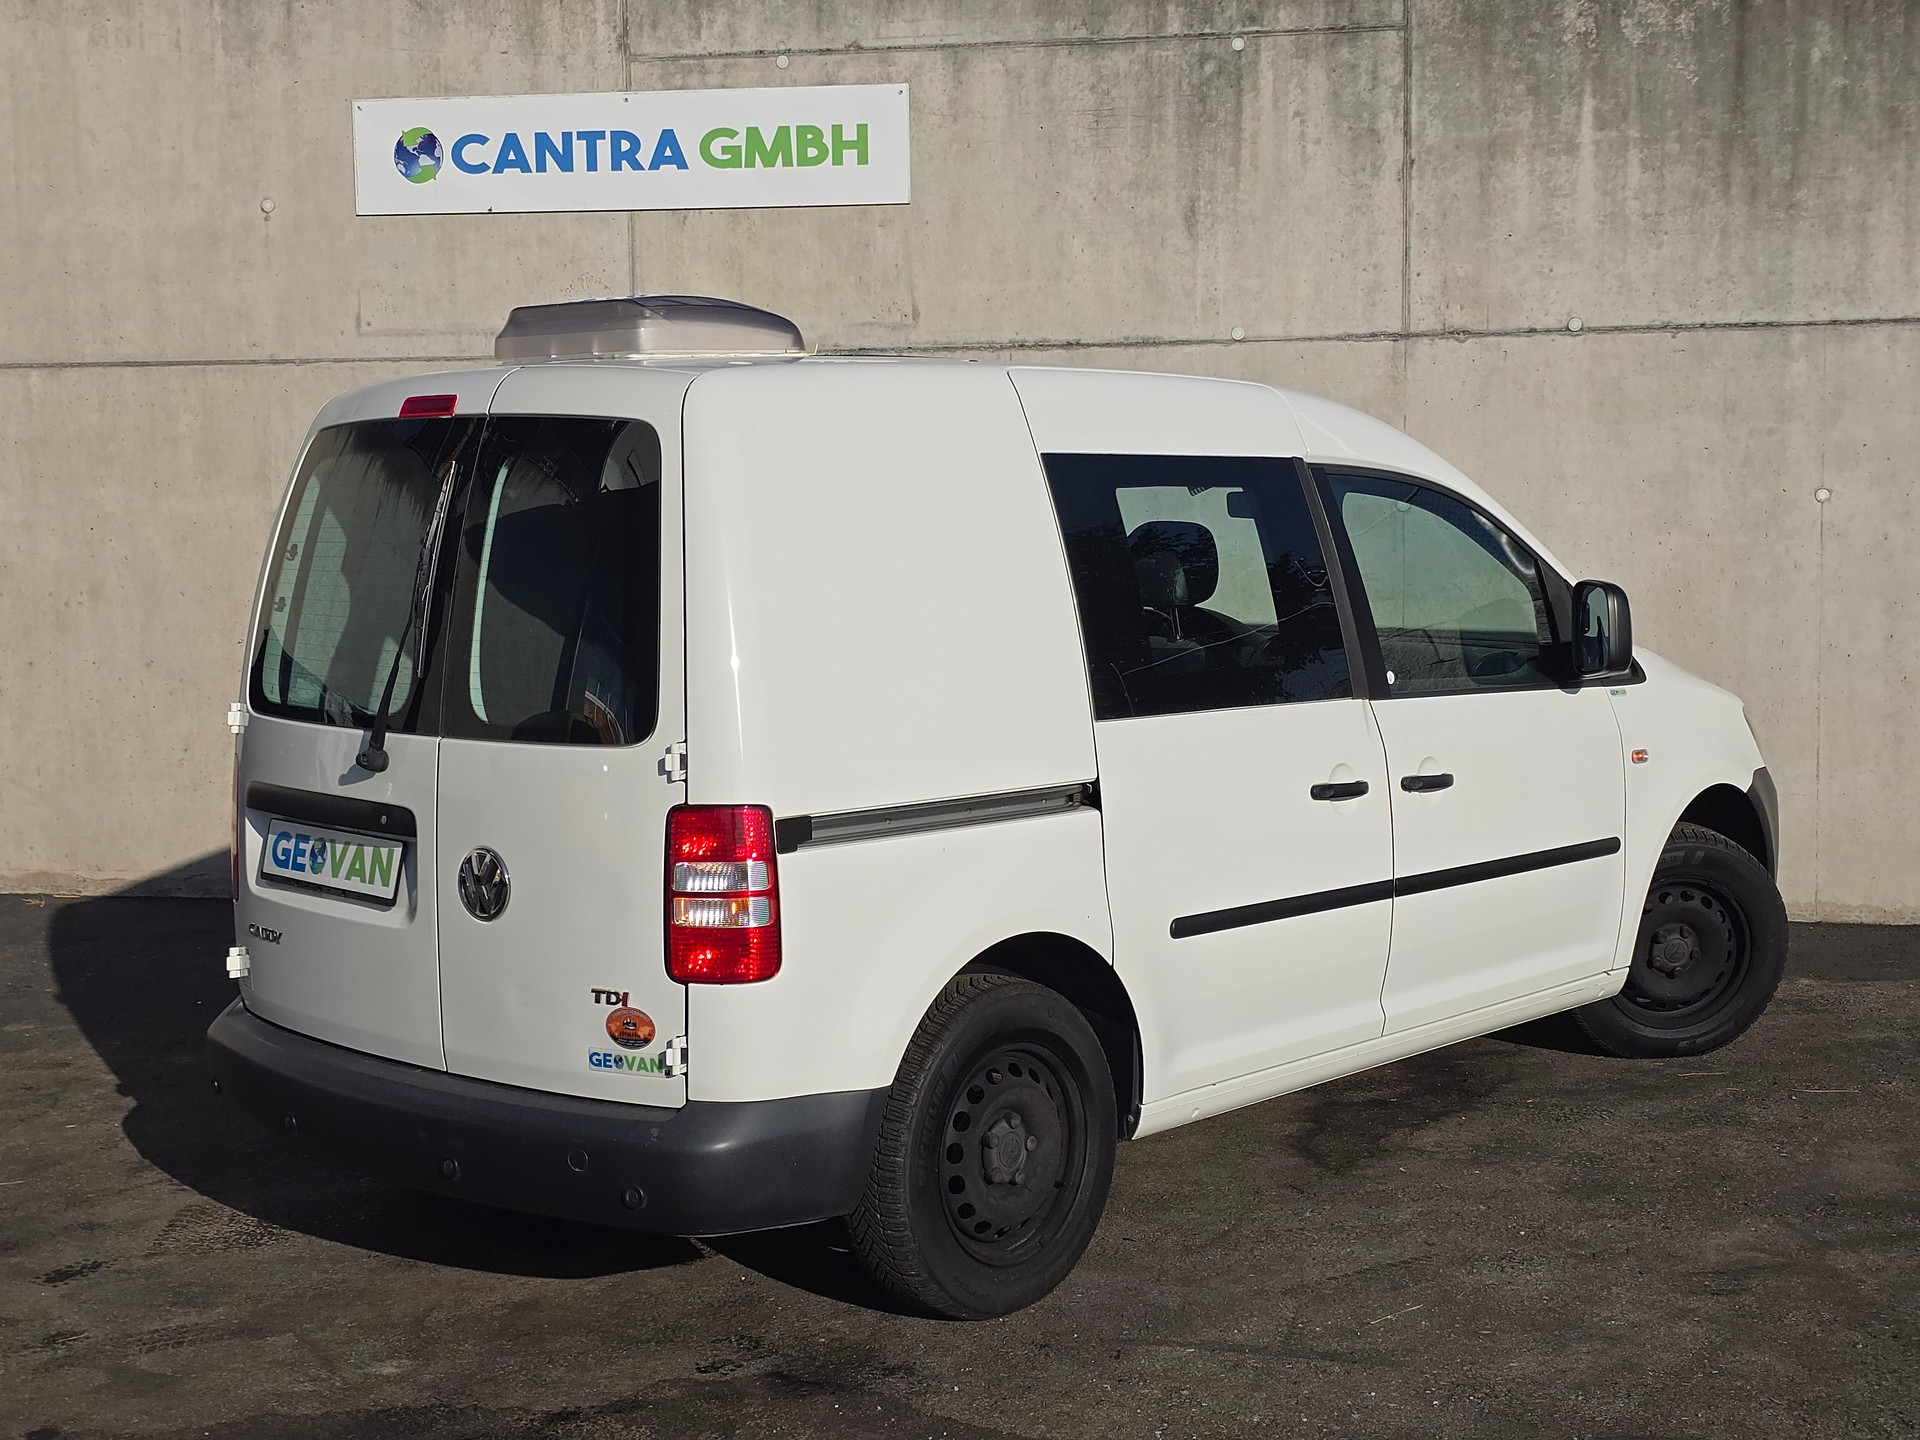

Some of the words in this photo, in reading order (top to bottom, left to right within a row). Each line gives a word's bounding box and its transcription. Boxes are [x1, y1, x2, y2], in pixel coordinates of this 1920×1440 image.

[451, 128, 690, 175] CANTRA
[699, 122, 870, 169] GMBH
[272, 831, 395, 887] GEOVAN
[249, 922, 283, 945] CADDY
[591, 988, 629, 1007] TDI
[588, 1051, 663, 1073] GEOVAN
